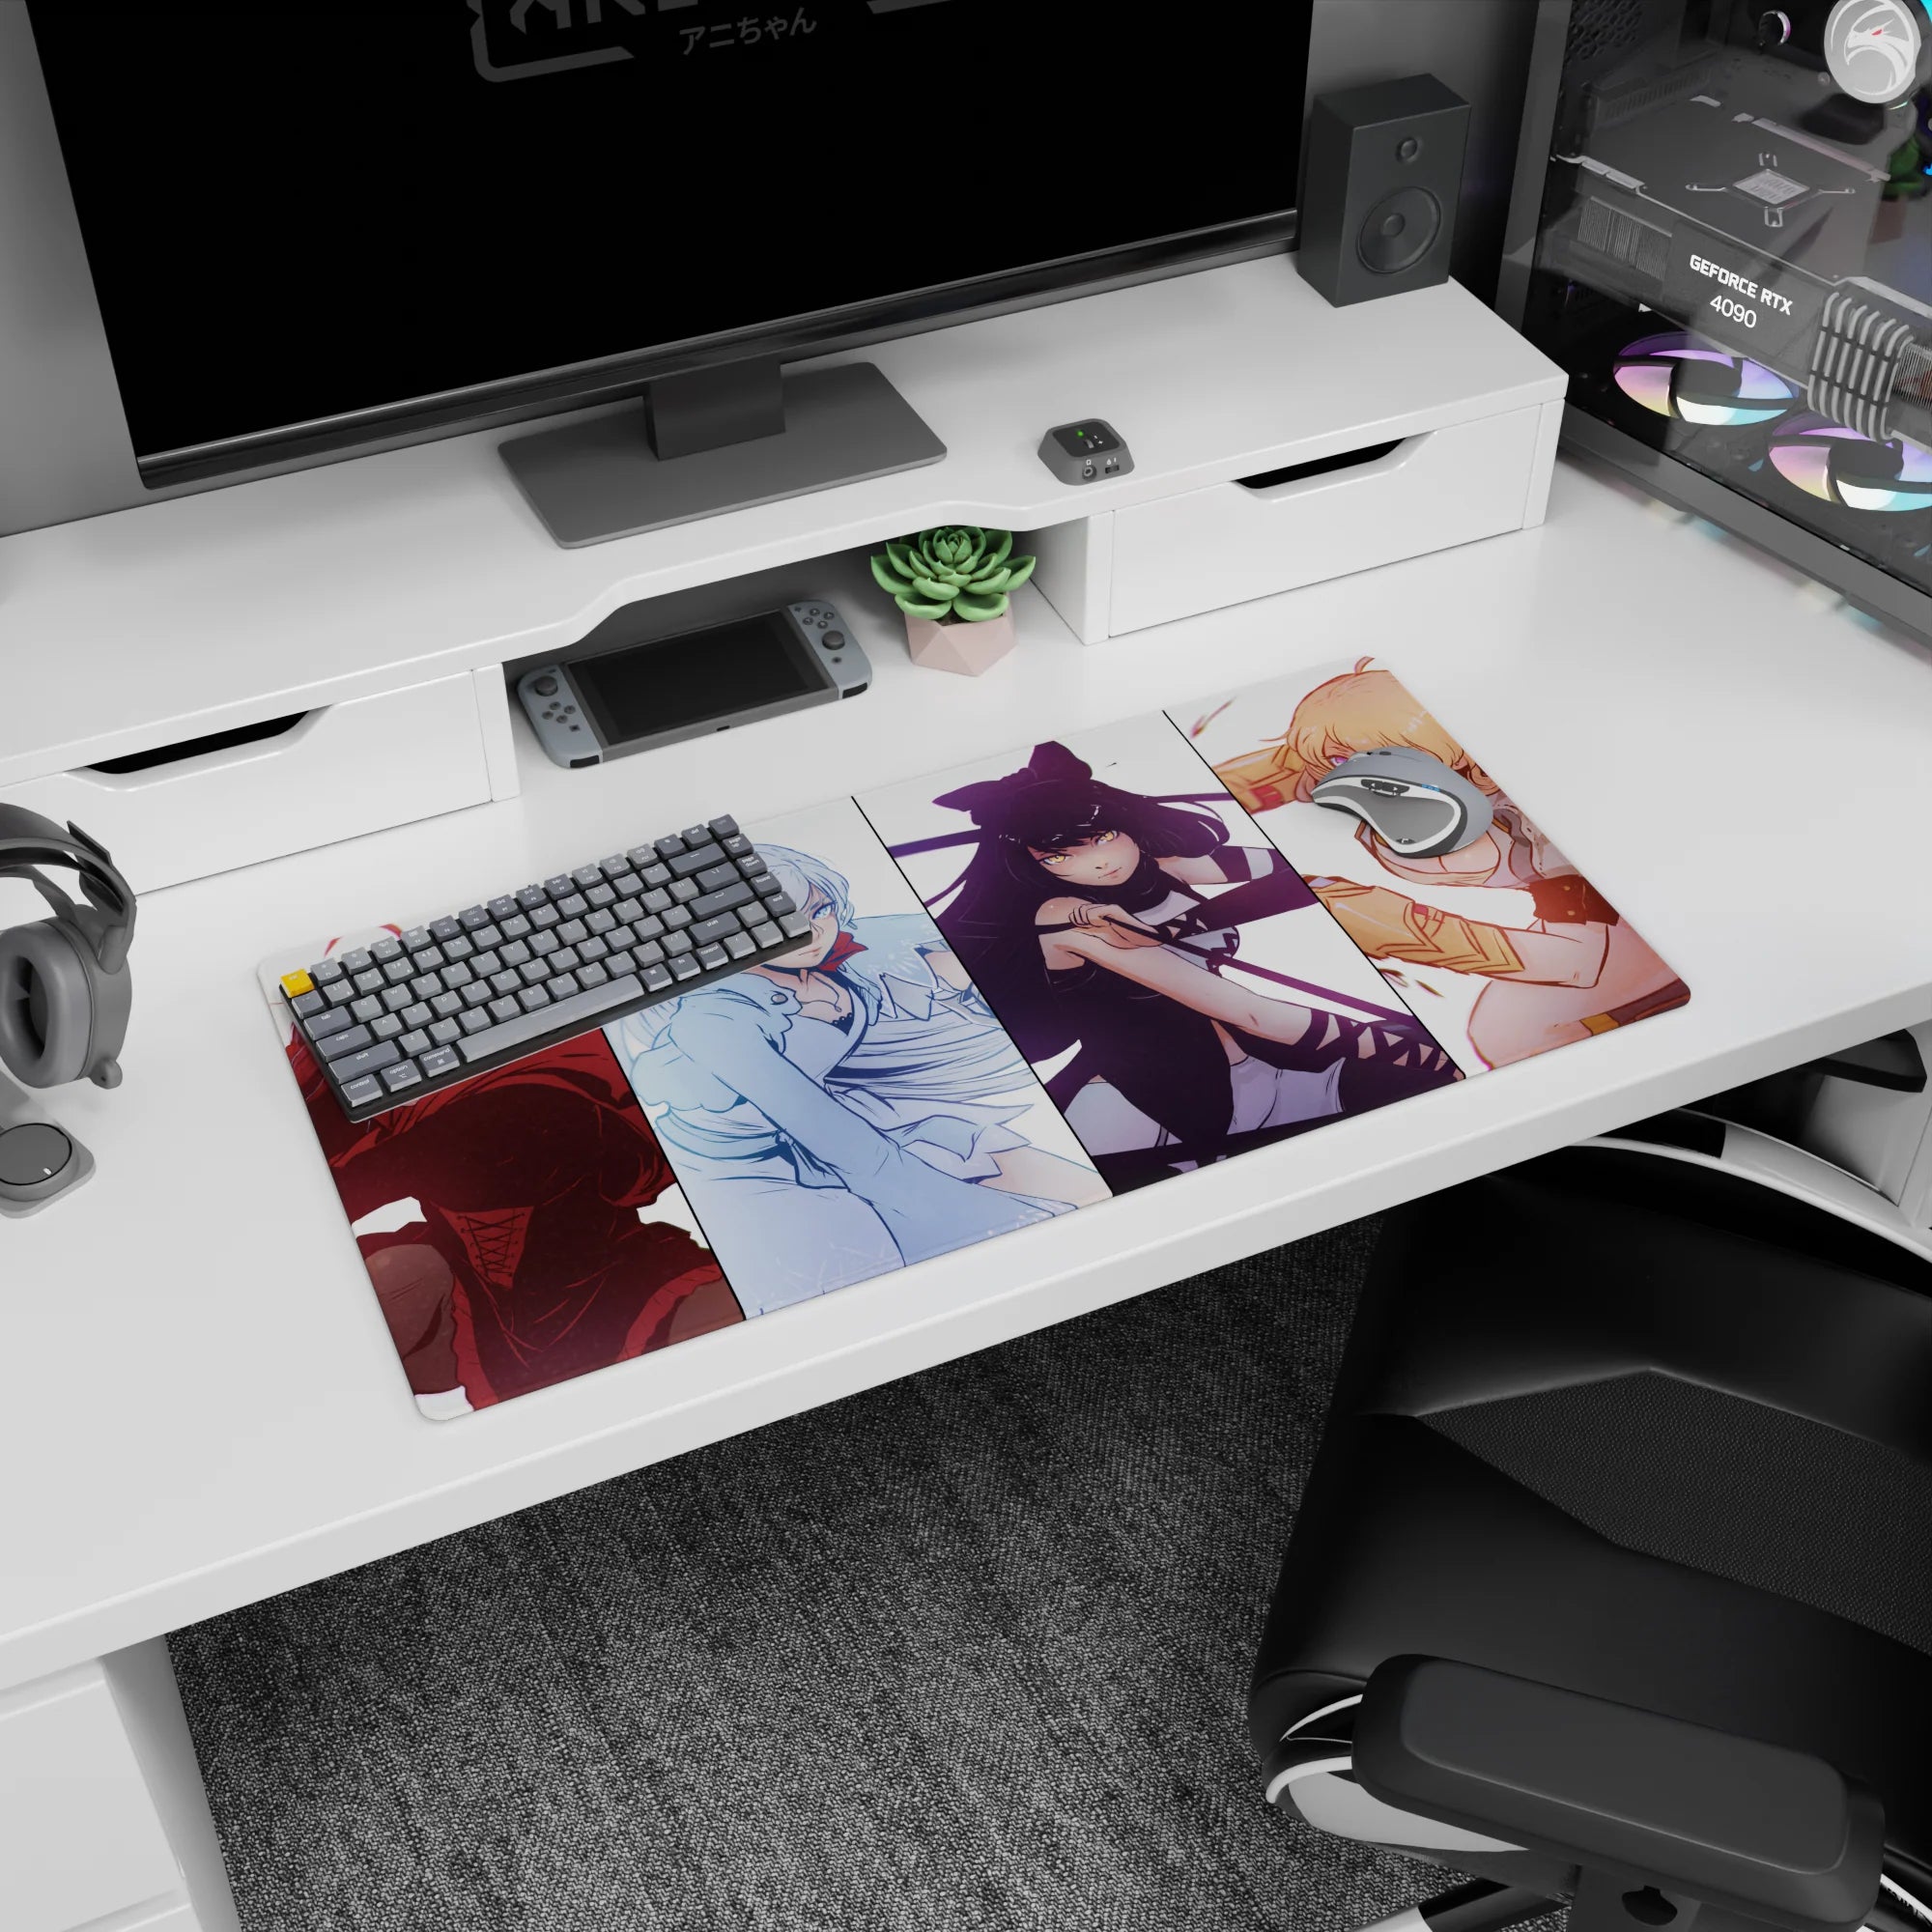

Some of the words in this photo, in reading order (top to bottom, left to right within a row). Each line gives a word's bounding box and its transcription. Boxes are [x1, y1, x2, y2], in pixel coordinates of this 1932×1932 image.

[679, 7, 817, 55] アニちゃん
[1690, 254, 1758, 298] GEFORCE
[1760, 288, 1793, 316] RTX
[1710, 295, 1757, 328] 4090
[700, 944, 719, 955] control
[423, 1046, 450, 1062] command
[389, 1065, 408, 1075] option
[350, 1078, 370, 1090] control
